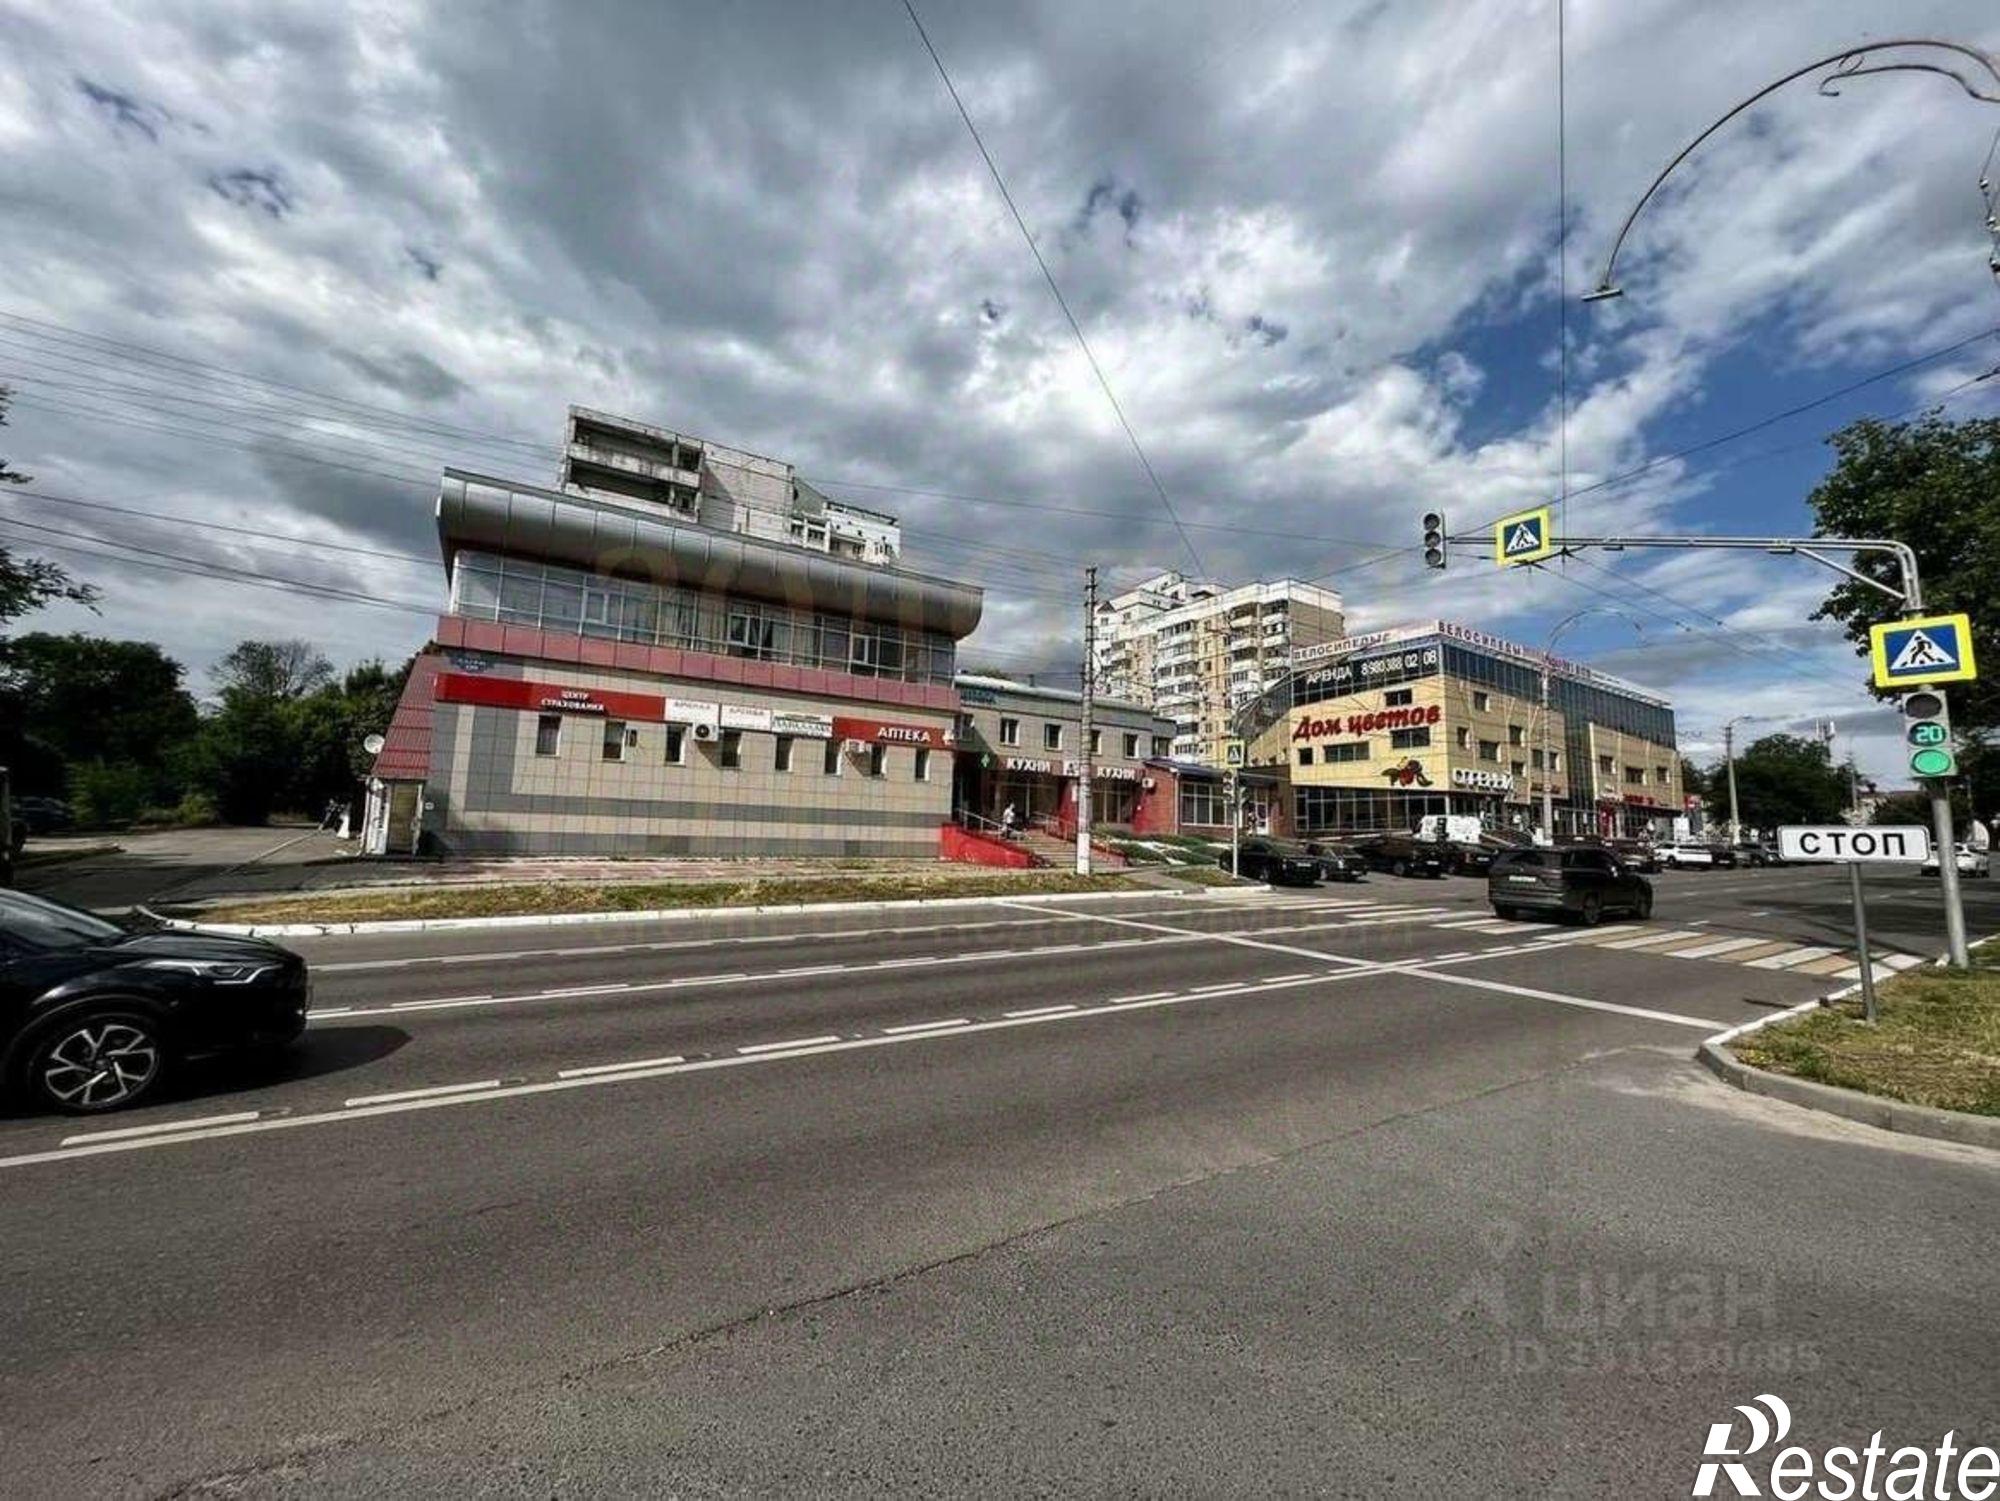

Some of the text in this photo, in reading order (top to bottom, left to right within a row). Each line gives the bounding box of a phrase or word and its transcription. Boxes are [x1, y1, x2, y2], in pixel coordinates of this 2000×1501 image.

[1438, 621, 1521, 655] ВЕЛОСИПЕДЫ
[1306, 666, 1353, 685] АРЕНДА
[1404, 653, 1418, 669] 02
[1423, 649, 1437, 666] 08
[1292, 704, 1442, 742] Дом цветов
[1916, 725, 1943, 742] 20
[877, 725, 931, 743] АПТЕКА
[1006, 757, 1051, 773] КУХНИ
[1097, 766, 1136, 780] КУХНИ
[1800, 832, 1906, 856] СТОП
